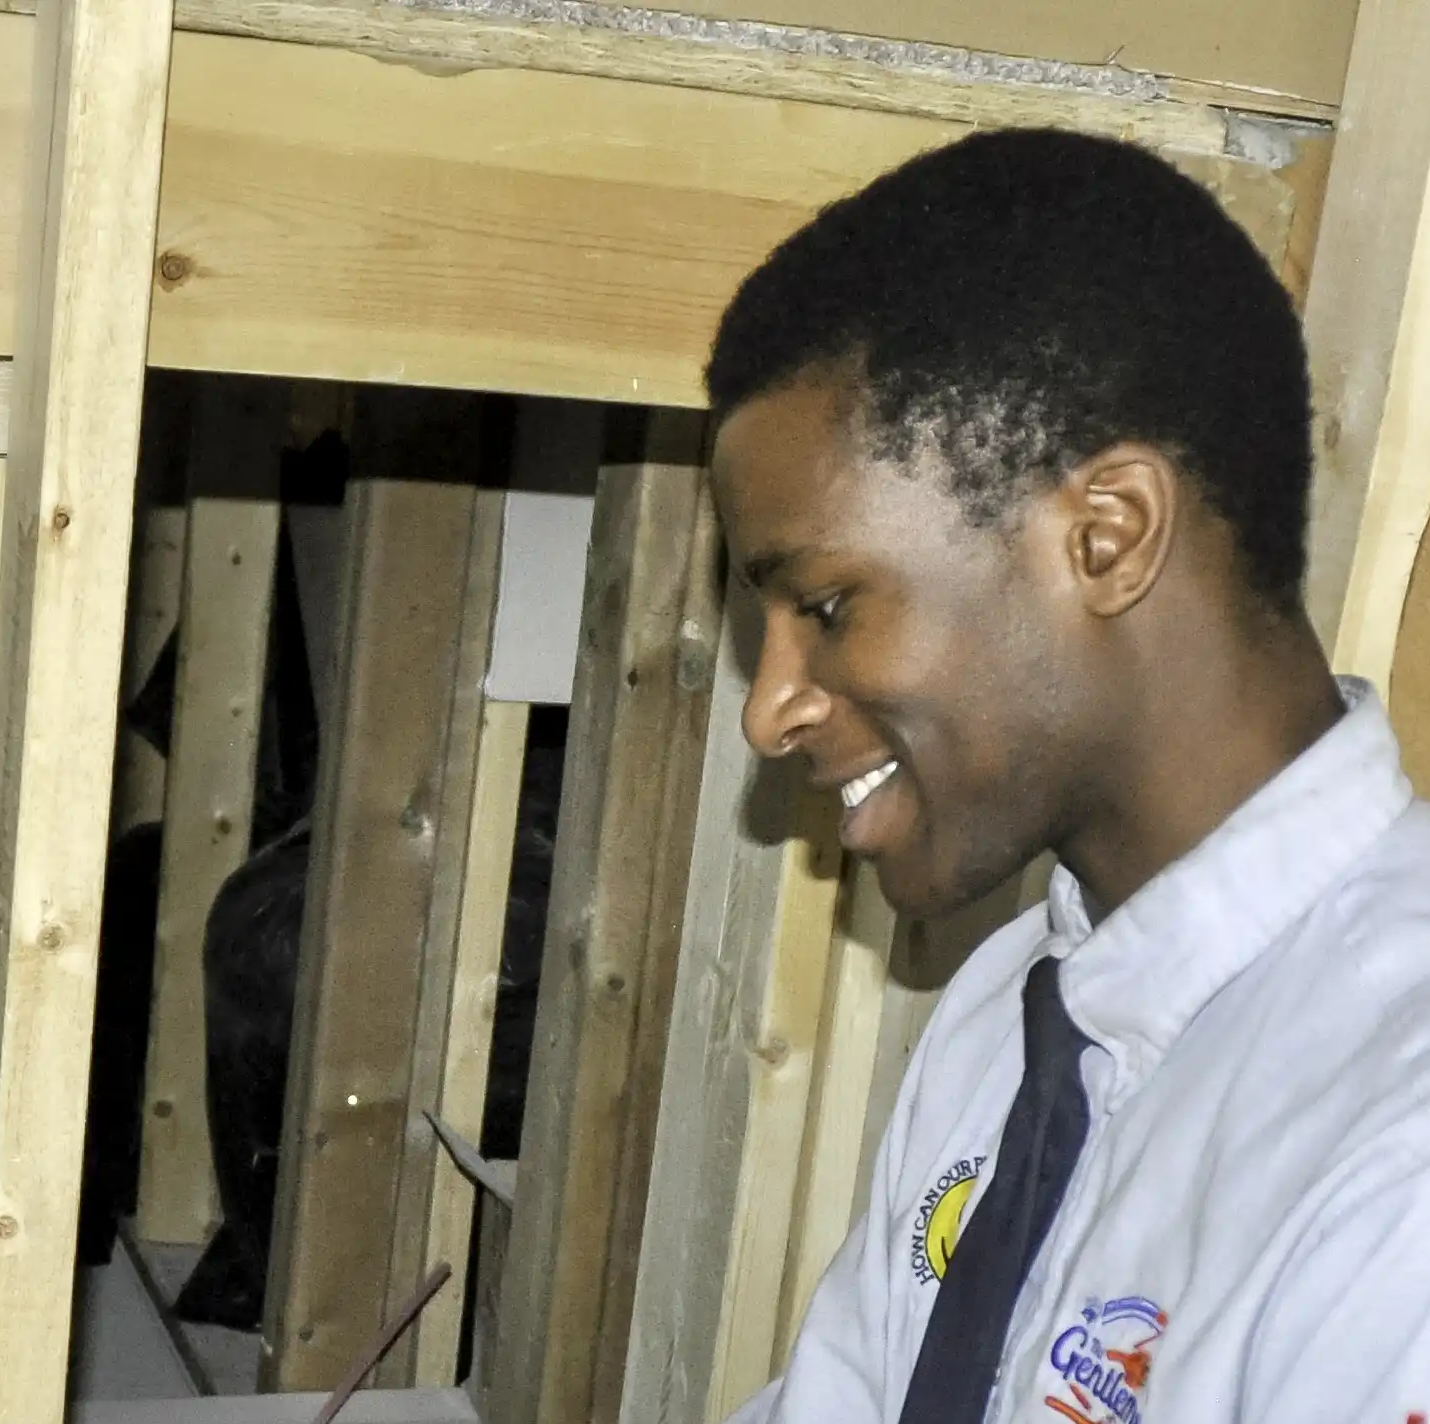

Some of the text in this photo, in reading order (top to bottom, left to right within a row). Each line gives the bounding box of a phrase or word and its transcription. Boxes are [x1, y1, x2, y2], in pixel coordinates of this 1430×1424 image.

[911, 1159, 973, 1286] HOW CAN OUR
